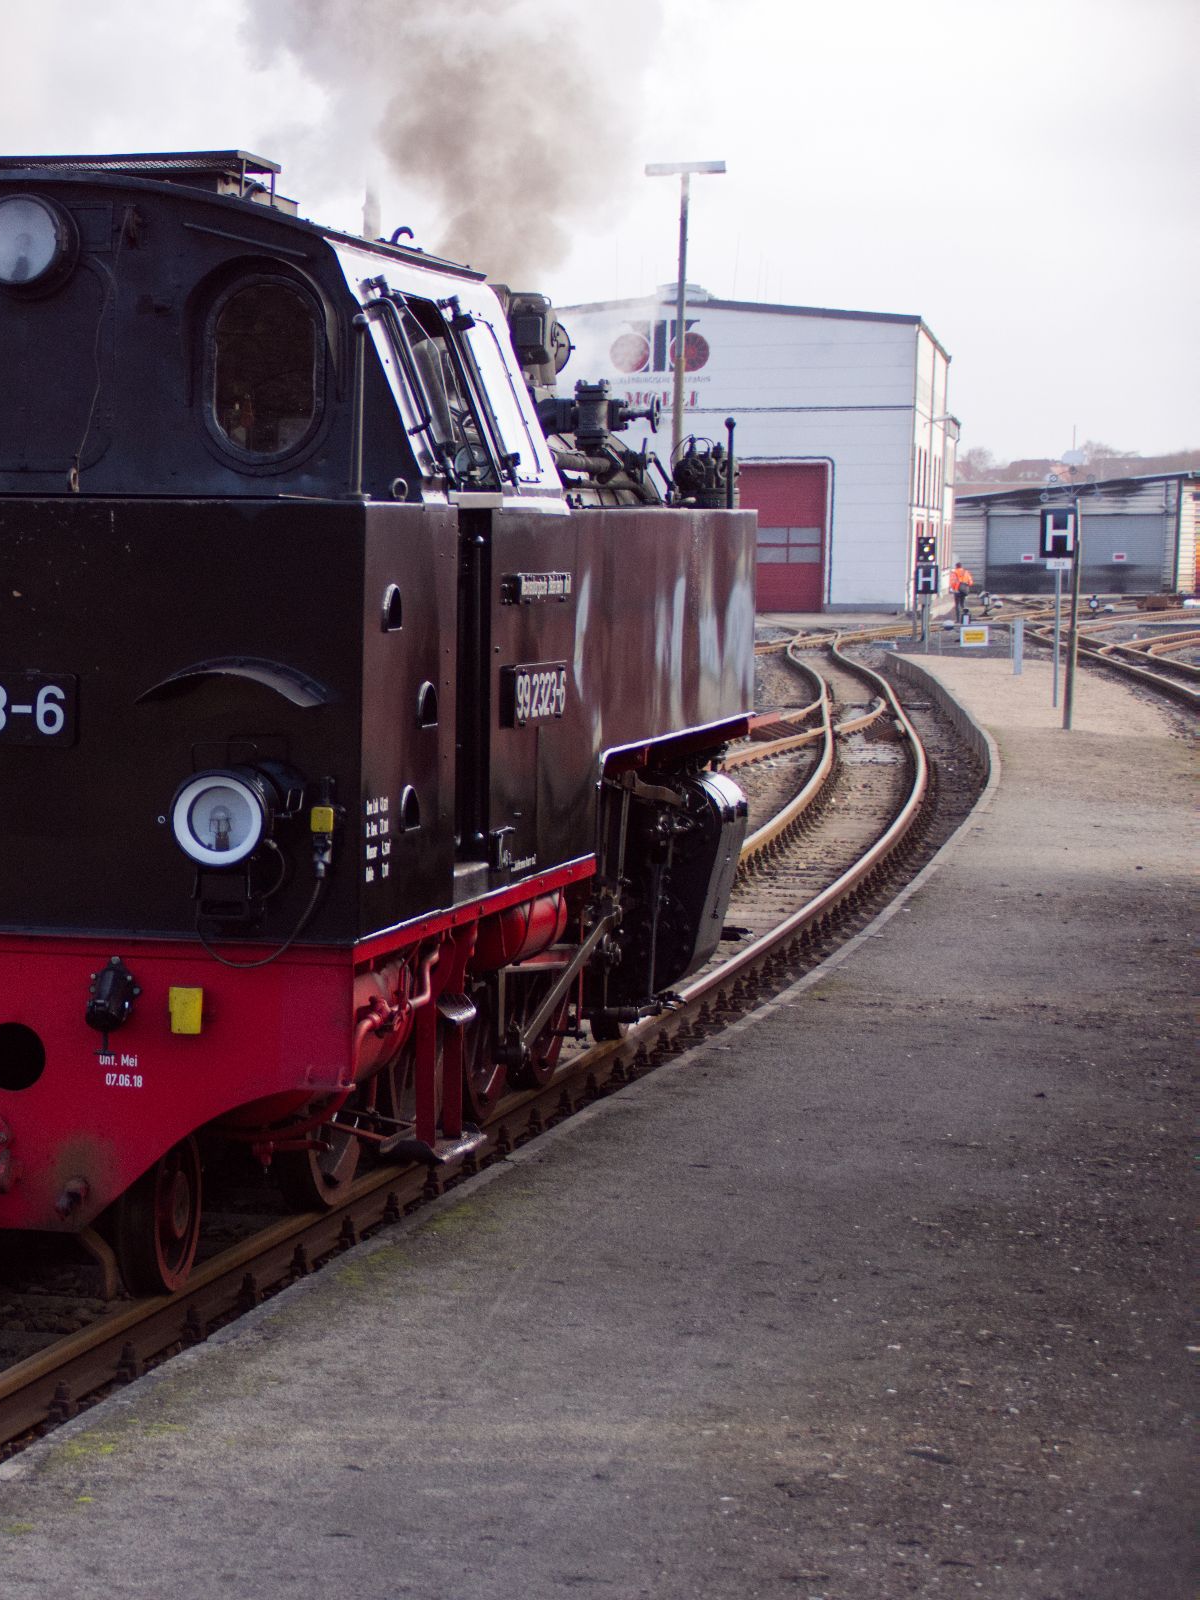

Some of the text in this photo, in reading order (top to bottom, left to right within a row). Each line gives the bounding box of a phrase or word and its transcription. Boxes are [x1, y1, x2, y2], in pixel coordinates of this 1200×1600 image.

[1046, 514, 1074, 551] H
[918, 568, 936, 591] H
[517, 670, 566, 719] 99 2323-6
[121, 1054, 138, 1067] Mei
[105, 1073, 143, 1088] 07.06.18
